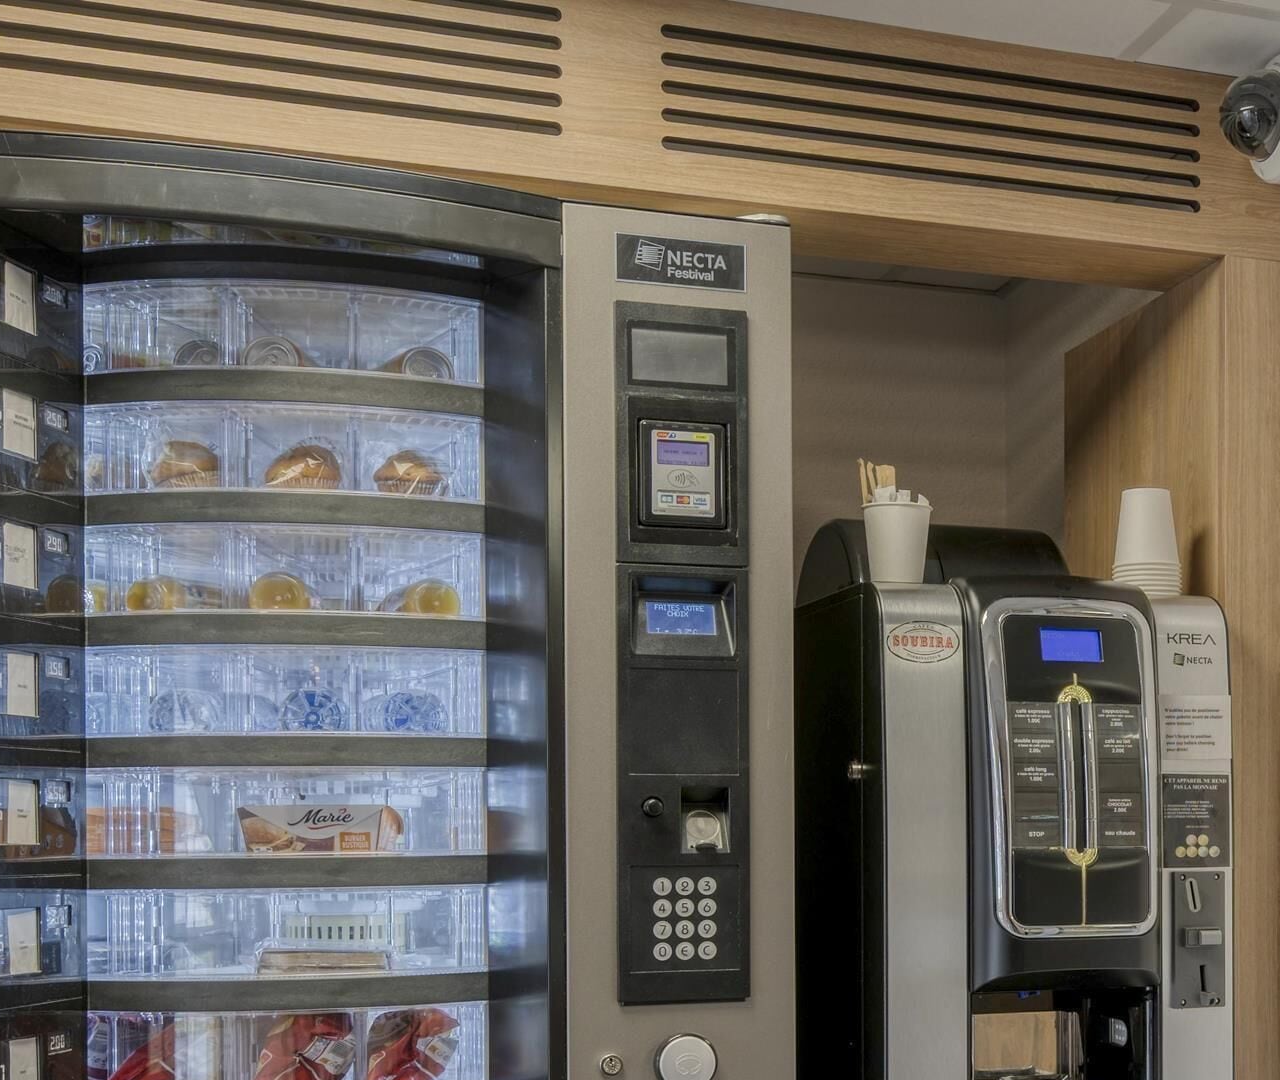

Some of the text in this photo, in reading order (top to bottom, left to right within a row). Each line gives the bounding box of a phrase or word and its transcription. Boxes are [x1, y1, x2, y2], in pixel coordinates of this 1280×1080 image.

[667, 249, 727, 270] NECTA
[667, 266, 714, 281] Festival
[654, 603, 680, 612] FAITES
[893, 634, 953, 648] SOUBIRA
[1167, 633, 1216, 646] KREA
[1187, 656, 1213, 664] NECTA
[287, 807, 354, 827] Marie
[660, 881, 665, 892] 1
[681, 880, 689, 892] 2
[703, 880, 711, 892] 3
[658, 903, 666, 914] 4
[681, 902, 689, 913] 5
[703, 902, 712, 913] 6
[659, 924, 667, 935] 7
[681, 924, 689, 935] 8
[703, 923, 712, 934] 9
[658, 946, 667, 957] 0
